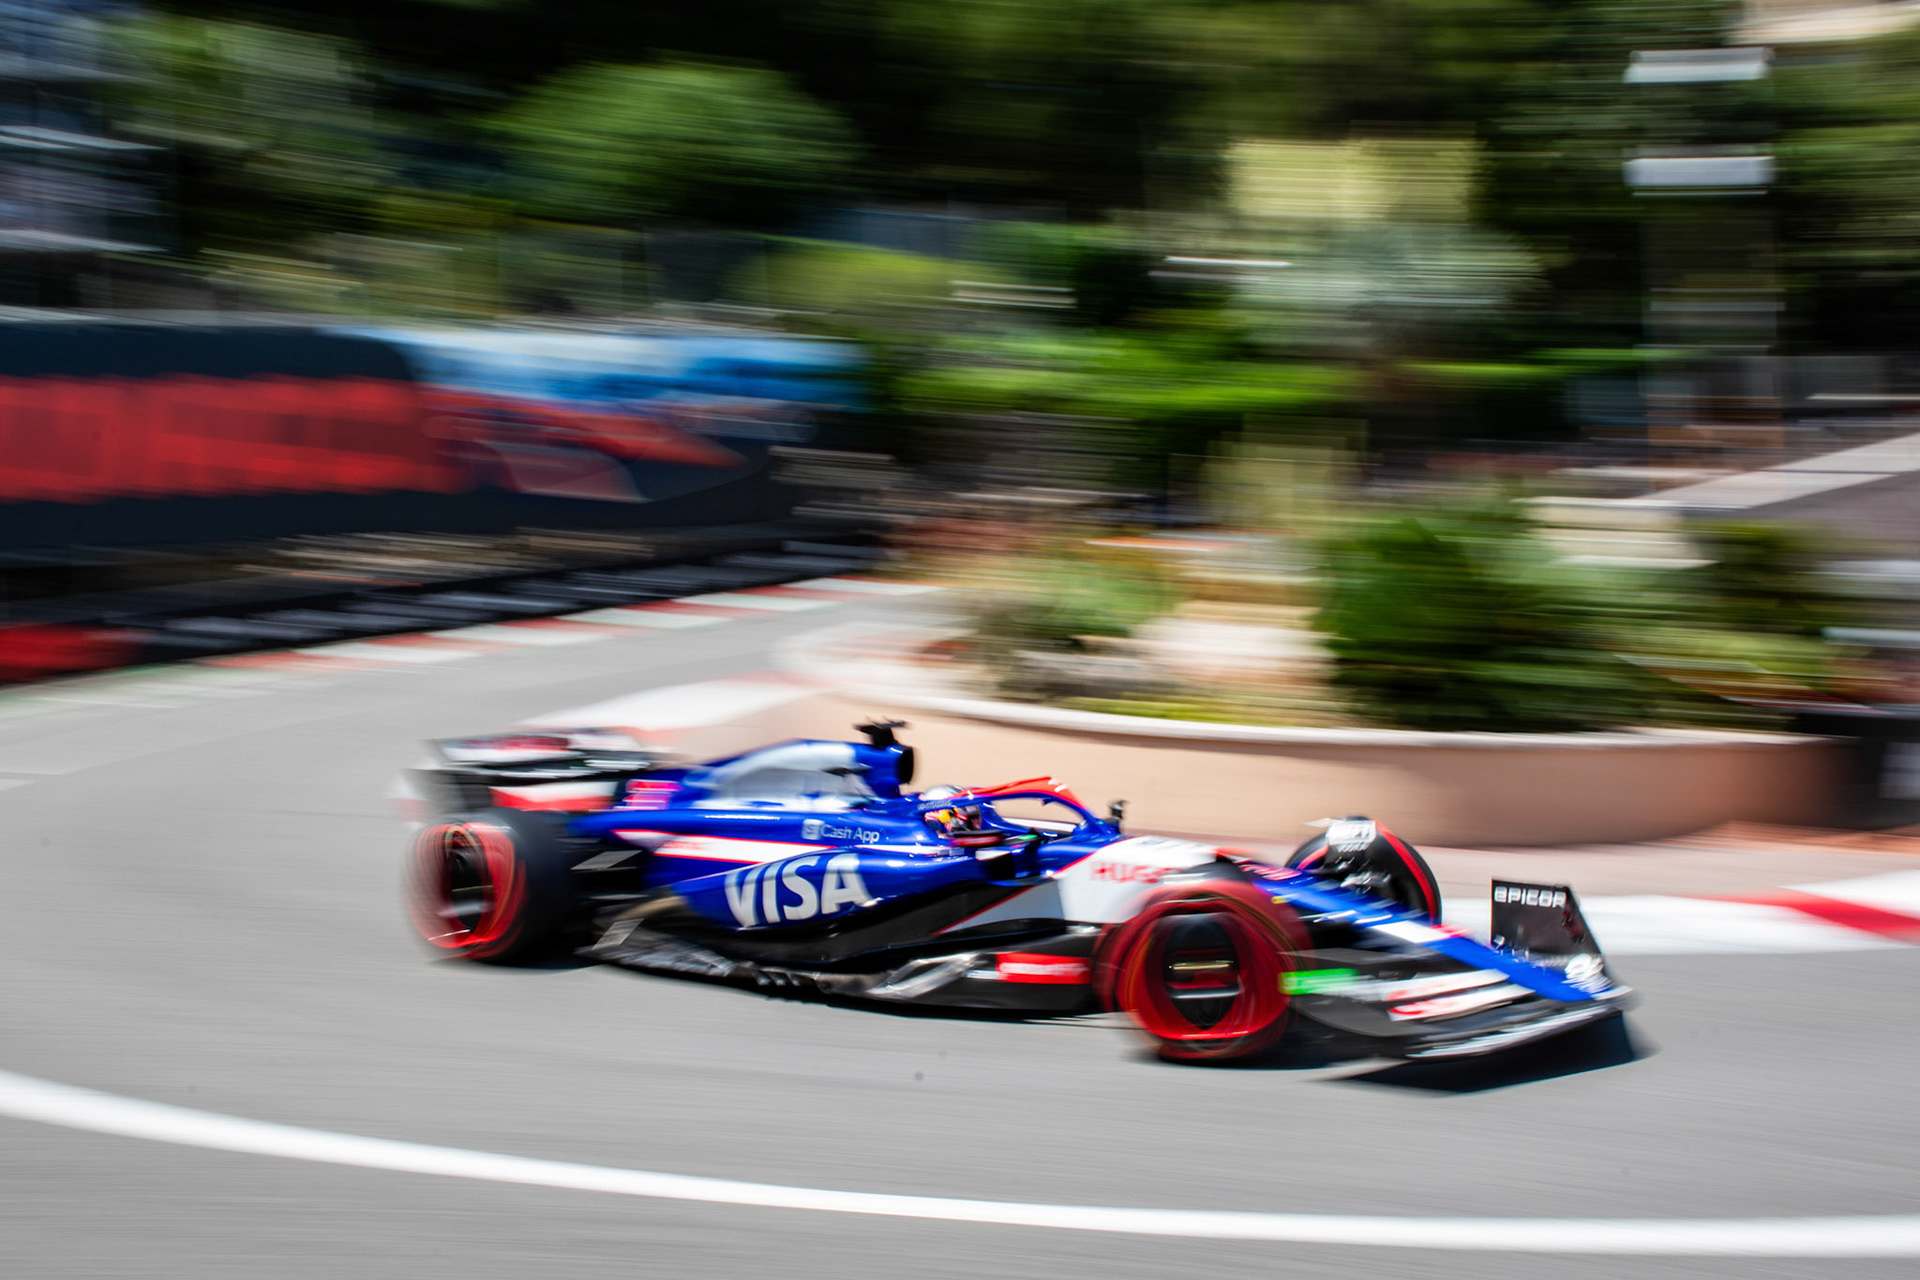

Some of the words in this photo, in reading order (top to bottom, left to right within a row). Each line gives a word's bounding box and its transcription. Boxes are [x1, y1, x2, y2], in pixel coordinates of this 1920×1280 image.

[821, 824, 852, 839] Cash
[853, 827, 880, 844] App
[724, 853, 873, 928] VISA
